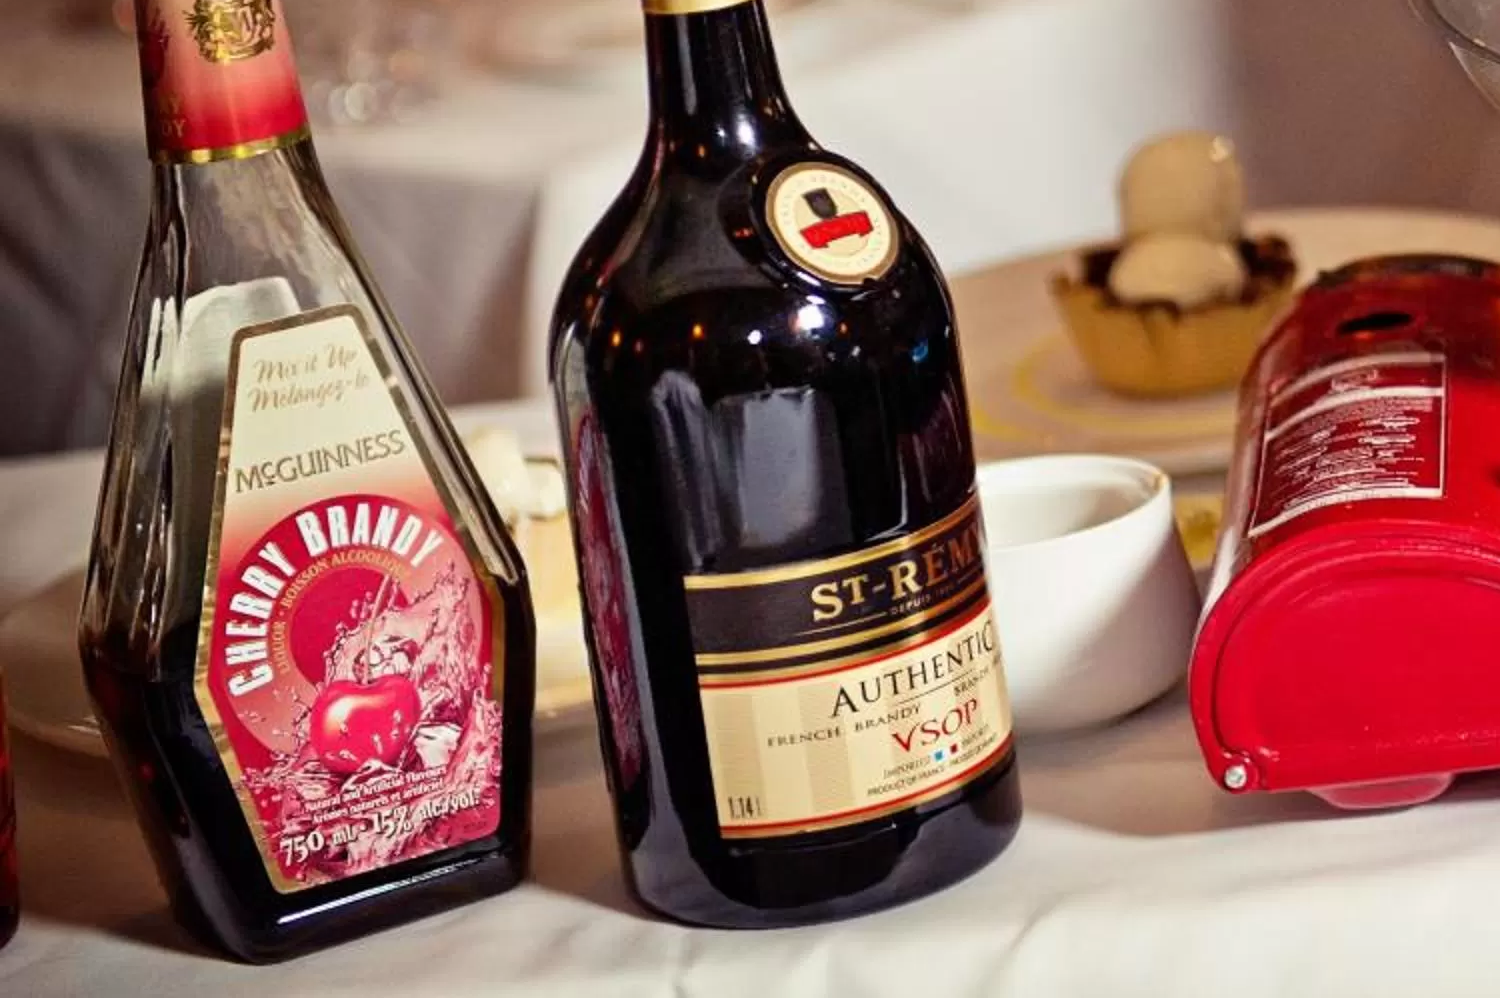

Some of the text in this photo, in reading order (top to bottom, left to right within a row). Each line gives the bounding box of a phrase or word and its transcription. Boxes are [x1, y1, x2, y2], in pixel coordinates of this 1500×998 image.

[234, 429, 405, 493] McGUINNESS
[225, 503, 444, 697] CHERRY BRANDY
[767, 702, 921, 748] FRENCH BRANDY
[891, 697, 978, 753] VSOP
[280, 831, 324, 867] 750
